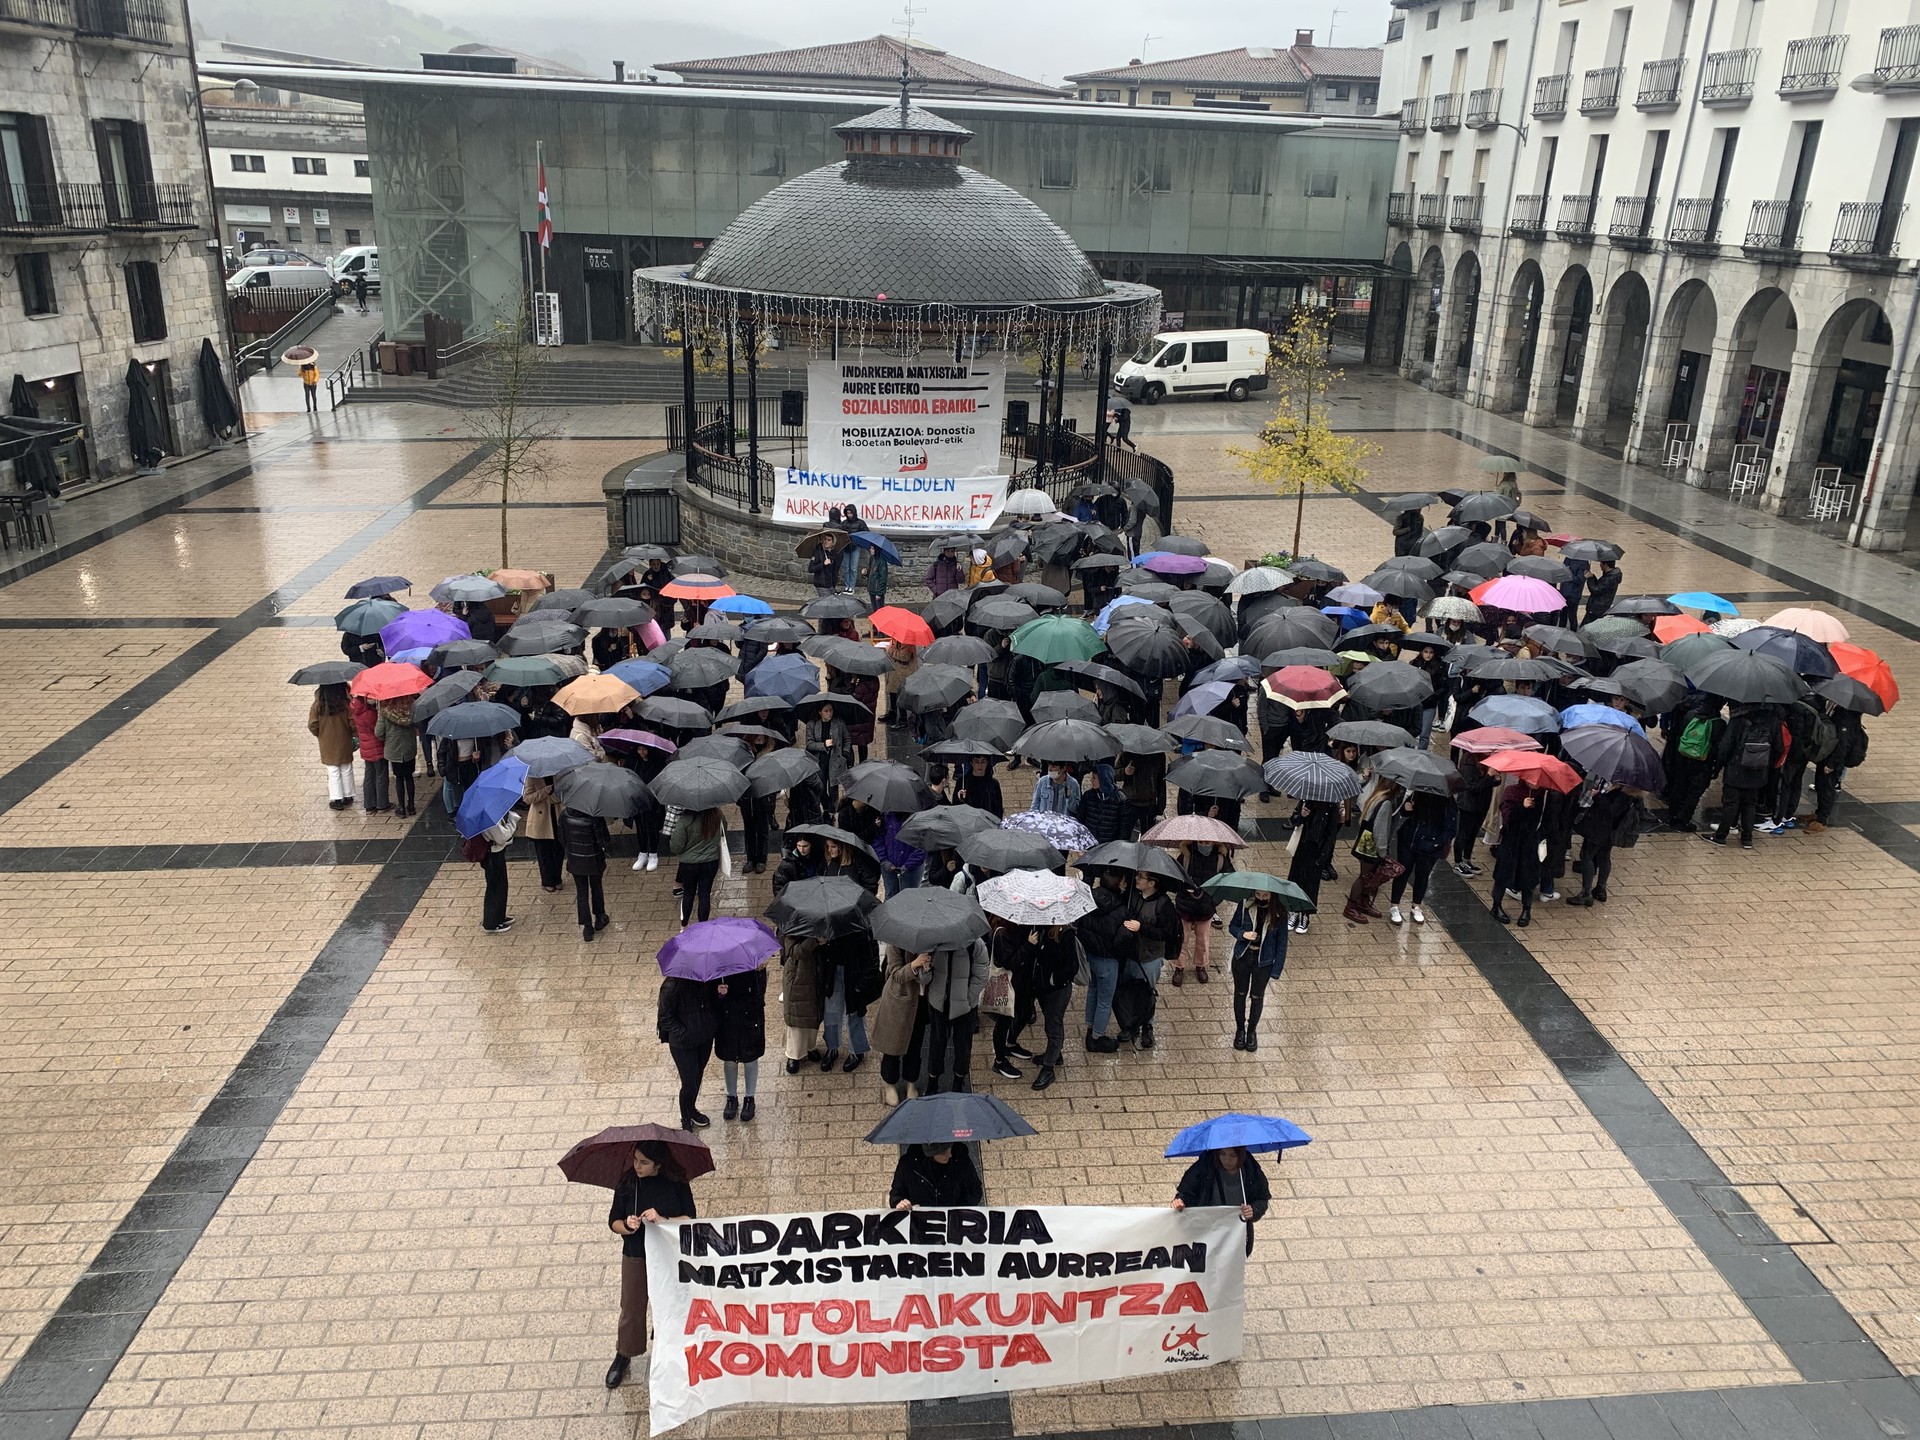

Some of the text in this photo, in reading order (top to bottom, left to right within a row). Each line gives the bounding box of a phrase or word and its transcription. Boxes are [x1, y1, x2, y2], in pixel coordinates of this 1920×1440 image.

[584, 246, 613, 254] Komunak
[842, 366, 967, 379] INDARKERIA MATXISTARI
[842, 382, 919, 395] AURRE EGITEKO
[842, 398, 976, 415] SOZIALISMOA ERAIKI!
[842, 426, 975, 437] MOBILIZAZIOA: Donostia
[842, 436, 963, 447] 18:00etan Boulevard-etik
[899, 454, 926, 465] itaia
[787, 469, 955, 492] EMAKUME HELDUEN
[861, 503, 964, 521] INDARKERIARIK
[679, 1209, 1053, 1257] INDARKERIA
[678, 1241, 1207, 1289] MATXISTAREN AURREAN
[684, 1282, 1209, 1336] ANTOLAKUNTZA
[684, 1334, 1053, 1388] KOMUNISTA
